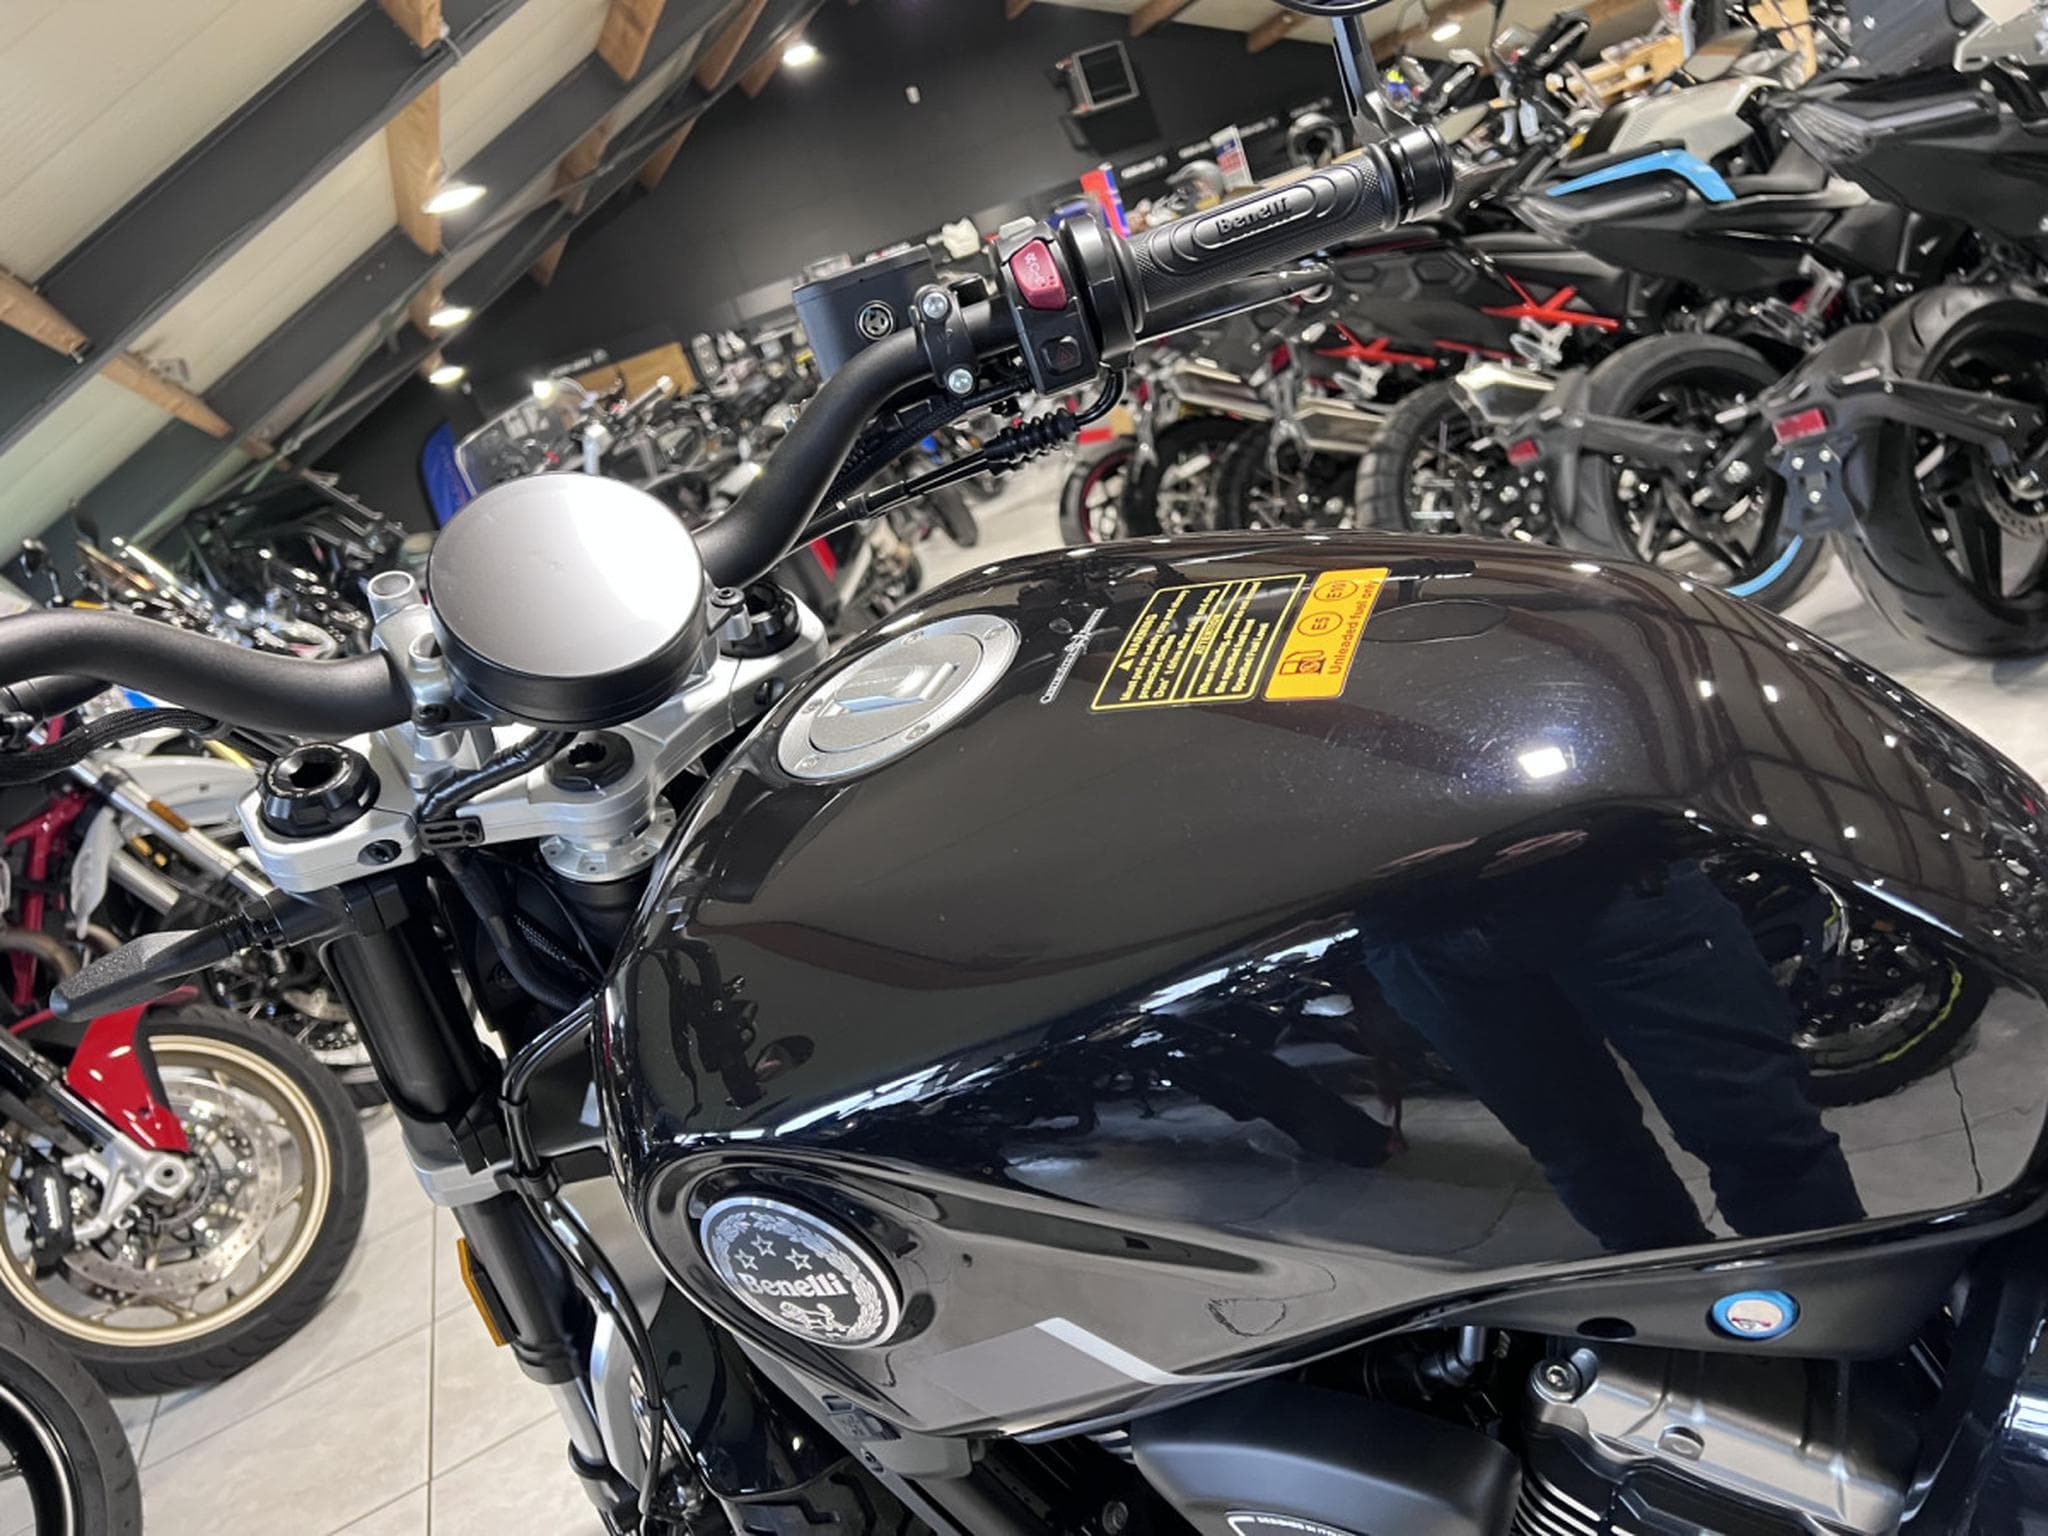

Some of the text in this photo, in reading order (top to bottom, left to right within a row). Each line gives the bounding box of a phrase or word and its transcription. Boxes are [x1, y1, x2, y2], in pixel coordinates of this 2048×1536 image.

[1327, 621, 1359, 674] Unleaded
[1350, 600, 1368, 618] fuel
[736, 1271, 849, 1297] Benelli
